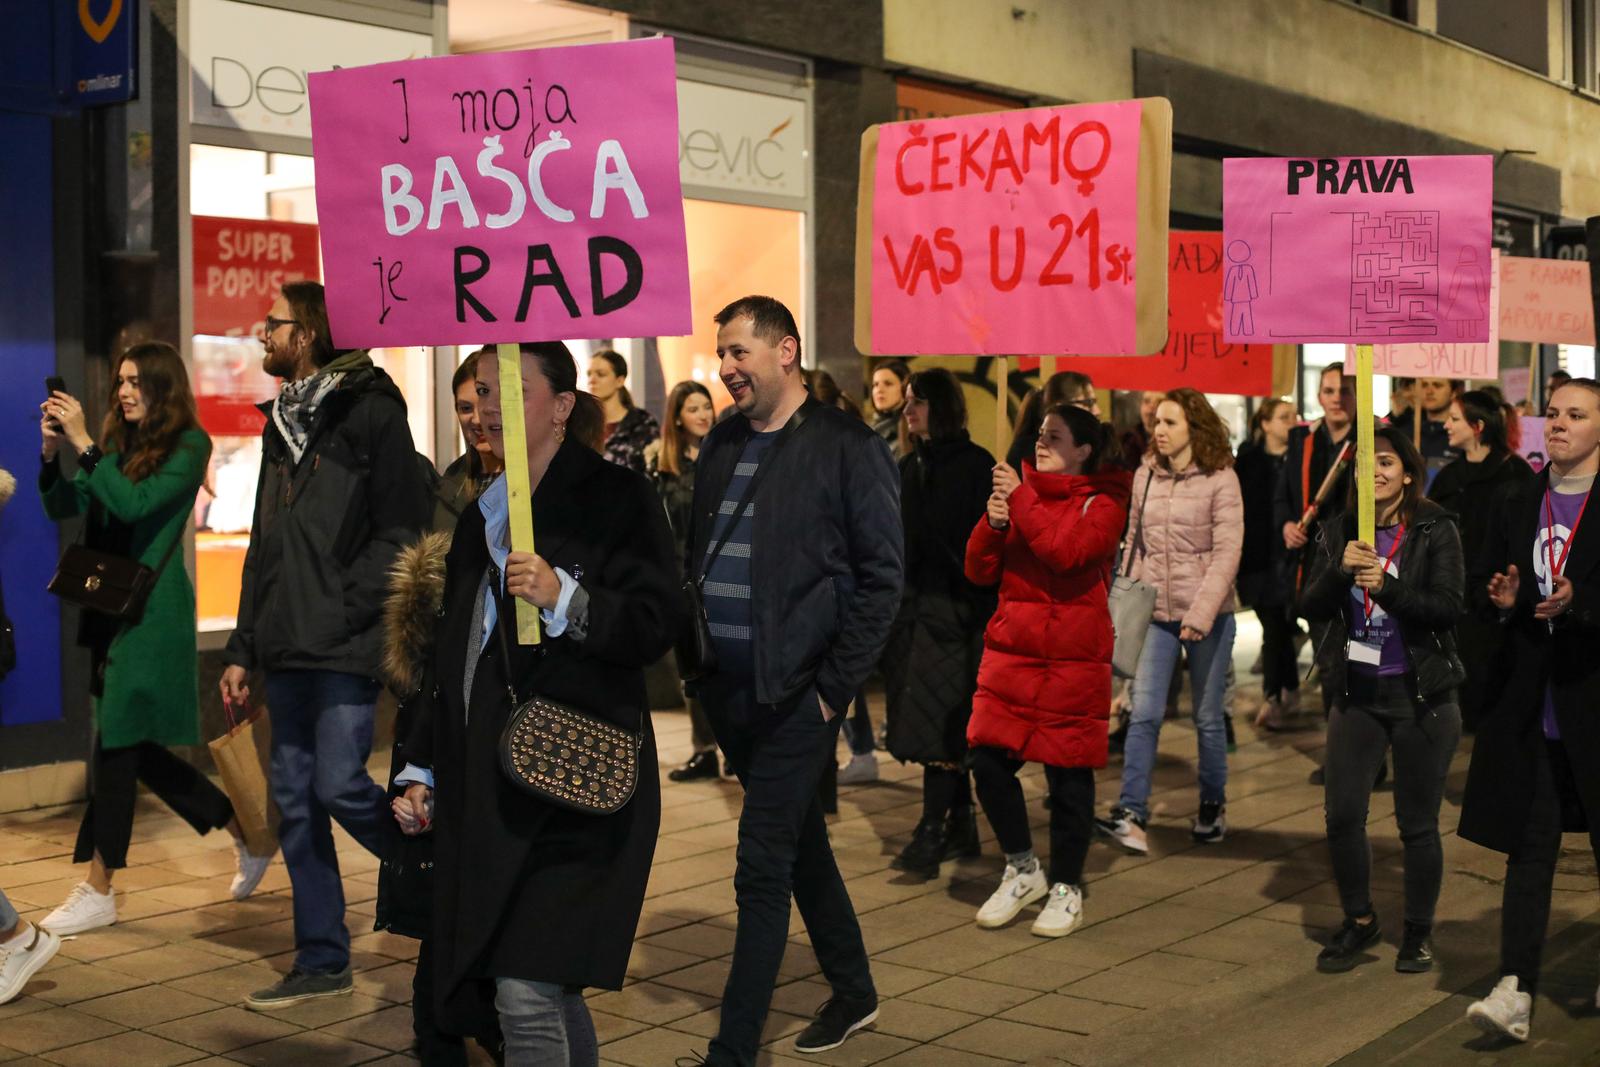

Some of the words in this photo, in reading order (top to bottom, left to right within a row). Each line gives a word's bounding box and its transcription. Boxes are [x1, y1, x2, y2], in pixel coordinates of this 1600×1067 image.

[452, 78, 577, 159] moja
[381, 130, 649, 236] BAŠČA
[1287, 158, 1415, 195] PRAVA
[217, 228, 295, 264] SUPER
[372, 256, 409, 325] je
[453, 235, 644, 323] RAD
[883, 227, 963, 297] VAS
[989, 225, 1026, 292] U
